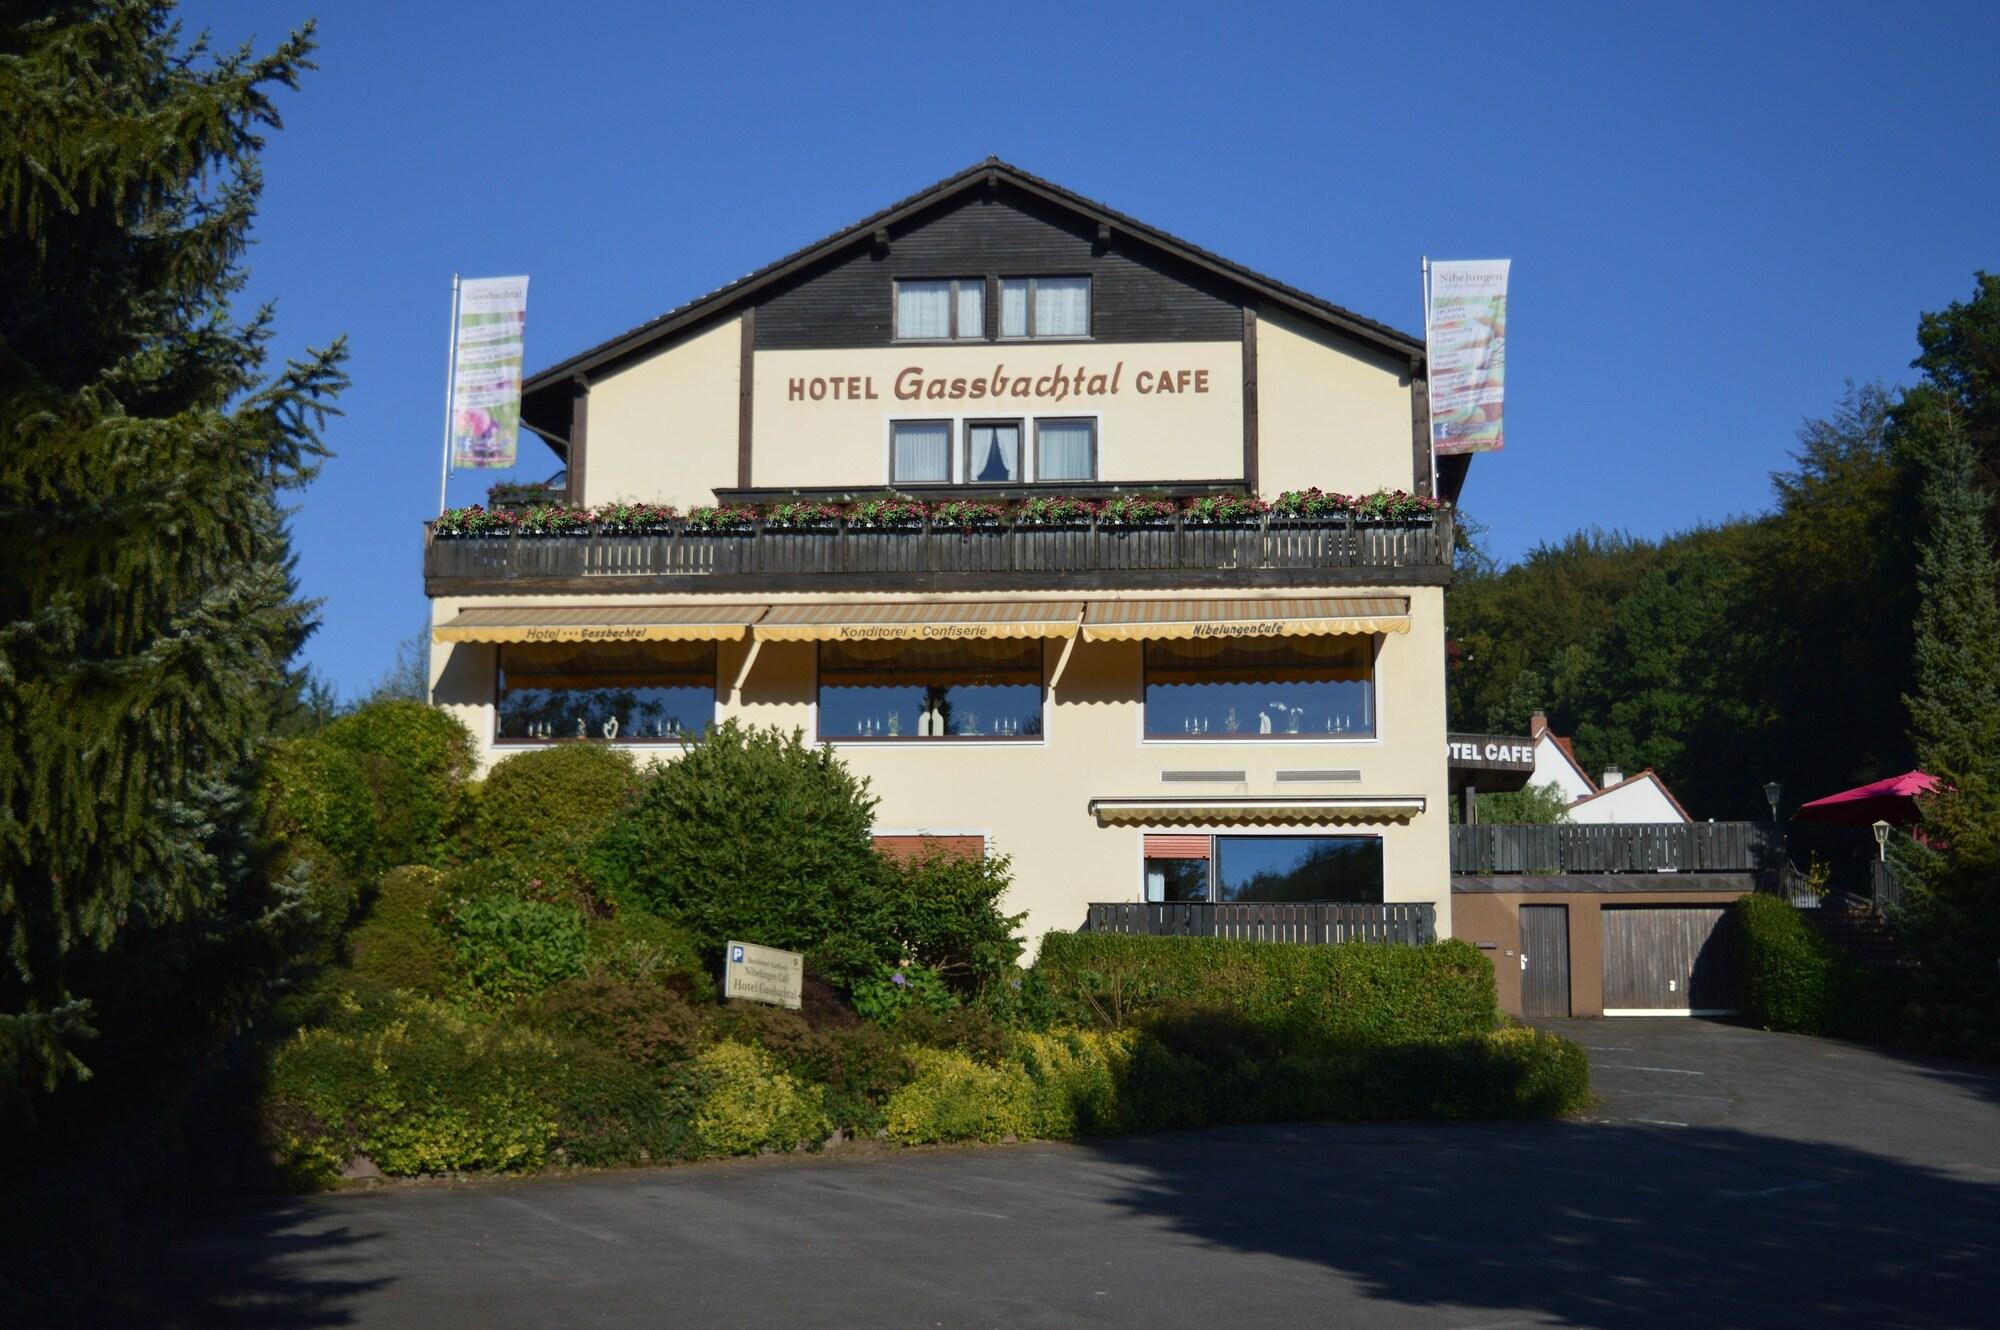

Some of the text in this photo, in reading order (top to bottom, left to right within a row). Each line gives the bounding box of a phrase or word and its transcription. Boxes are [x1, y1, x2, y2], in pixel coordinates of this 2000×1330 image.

[1440, 272, 1503, 284] Nibelungen
[788, 362, 1209, 402] HOTEL Gassbachtal CAFE
[526, 628, 560, 640] Hotel
[840, 625, 987, 638] Konditorei Confiserie
[1485, 743, 1532, 763] CAFE
[733, 948, 742, 961] P
[734, 979, 758, 993] Hotel
